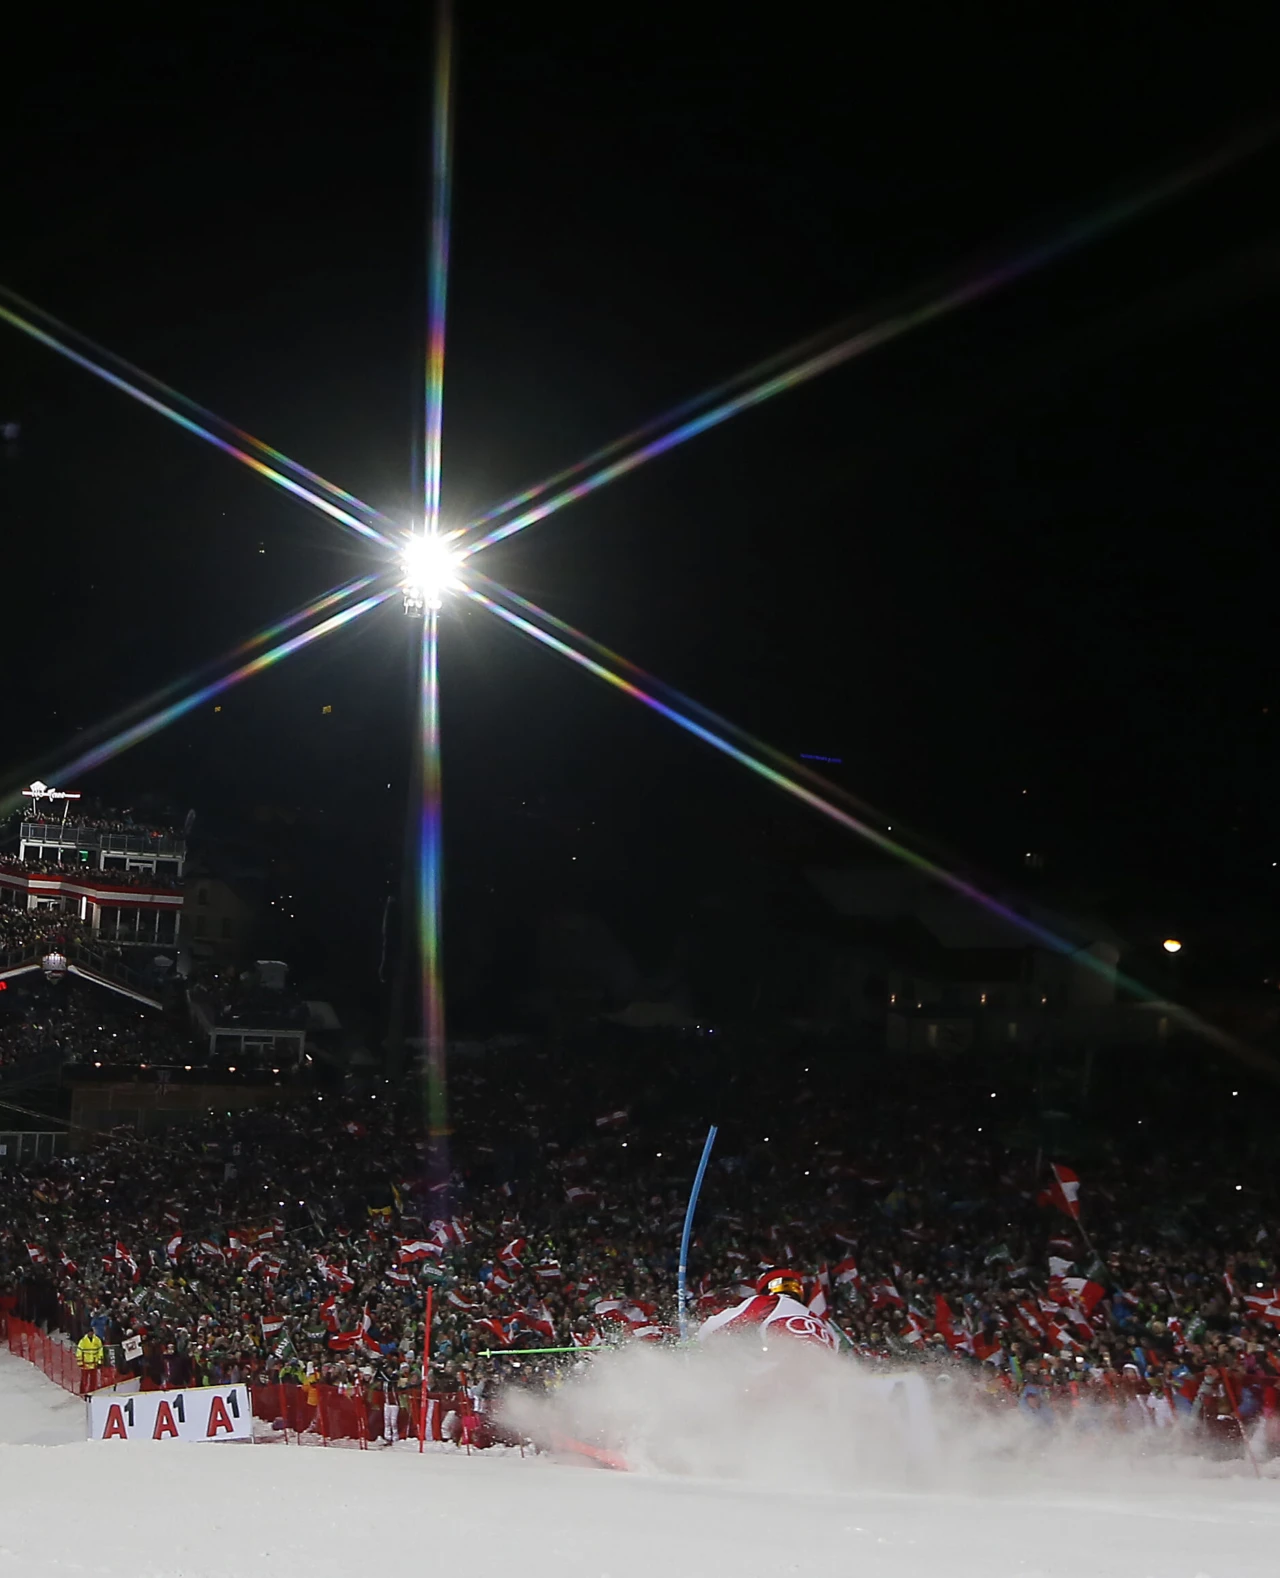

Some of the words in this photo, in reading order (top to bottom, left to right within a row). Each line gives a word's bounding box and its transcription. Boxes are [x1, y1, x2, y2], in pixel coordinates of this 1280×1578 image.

[102, 1398, 134, 1440] A1
[152, 1393, 185, 1440] A1
[206, 1389, 240, 1437] A1
